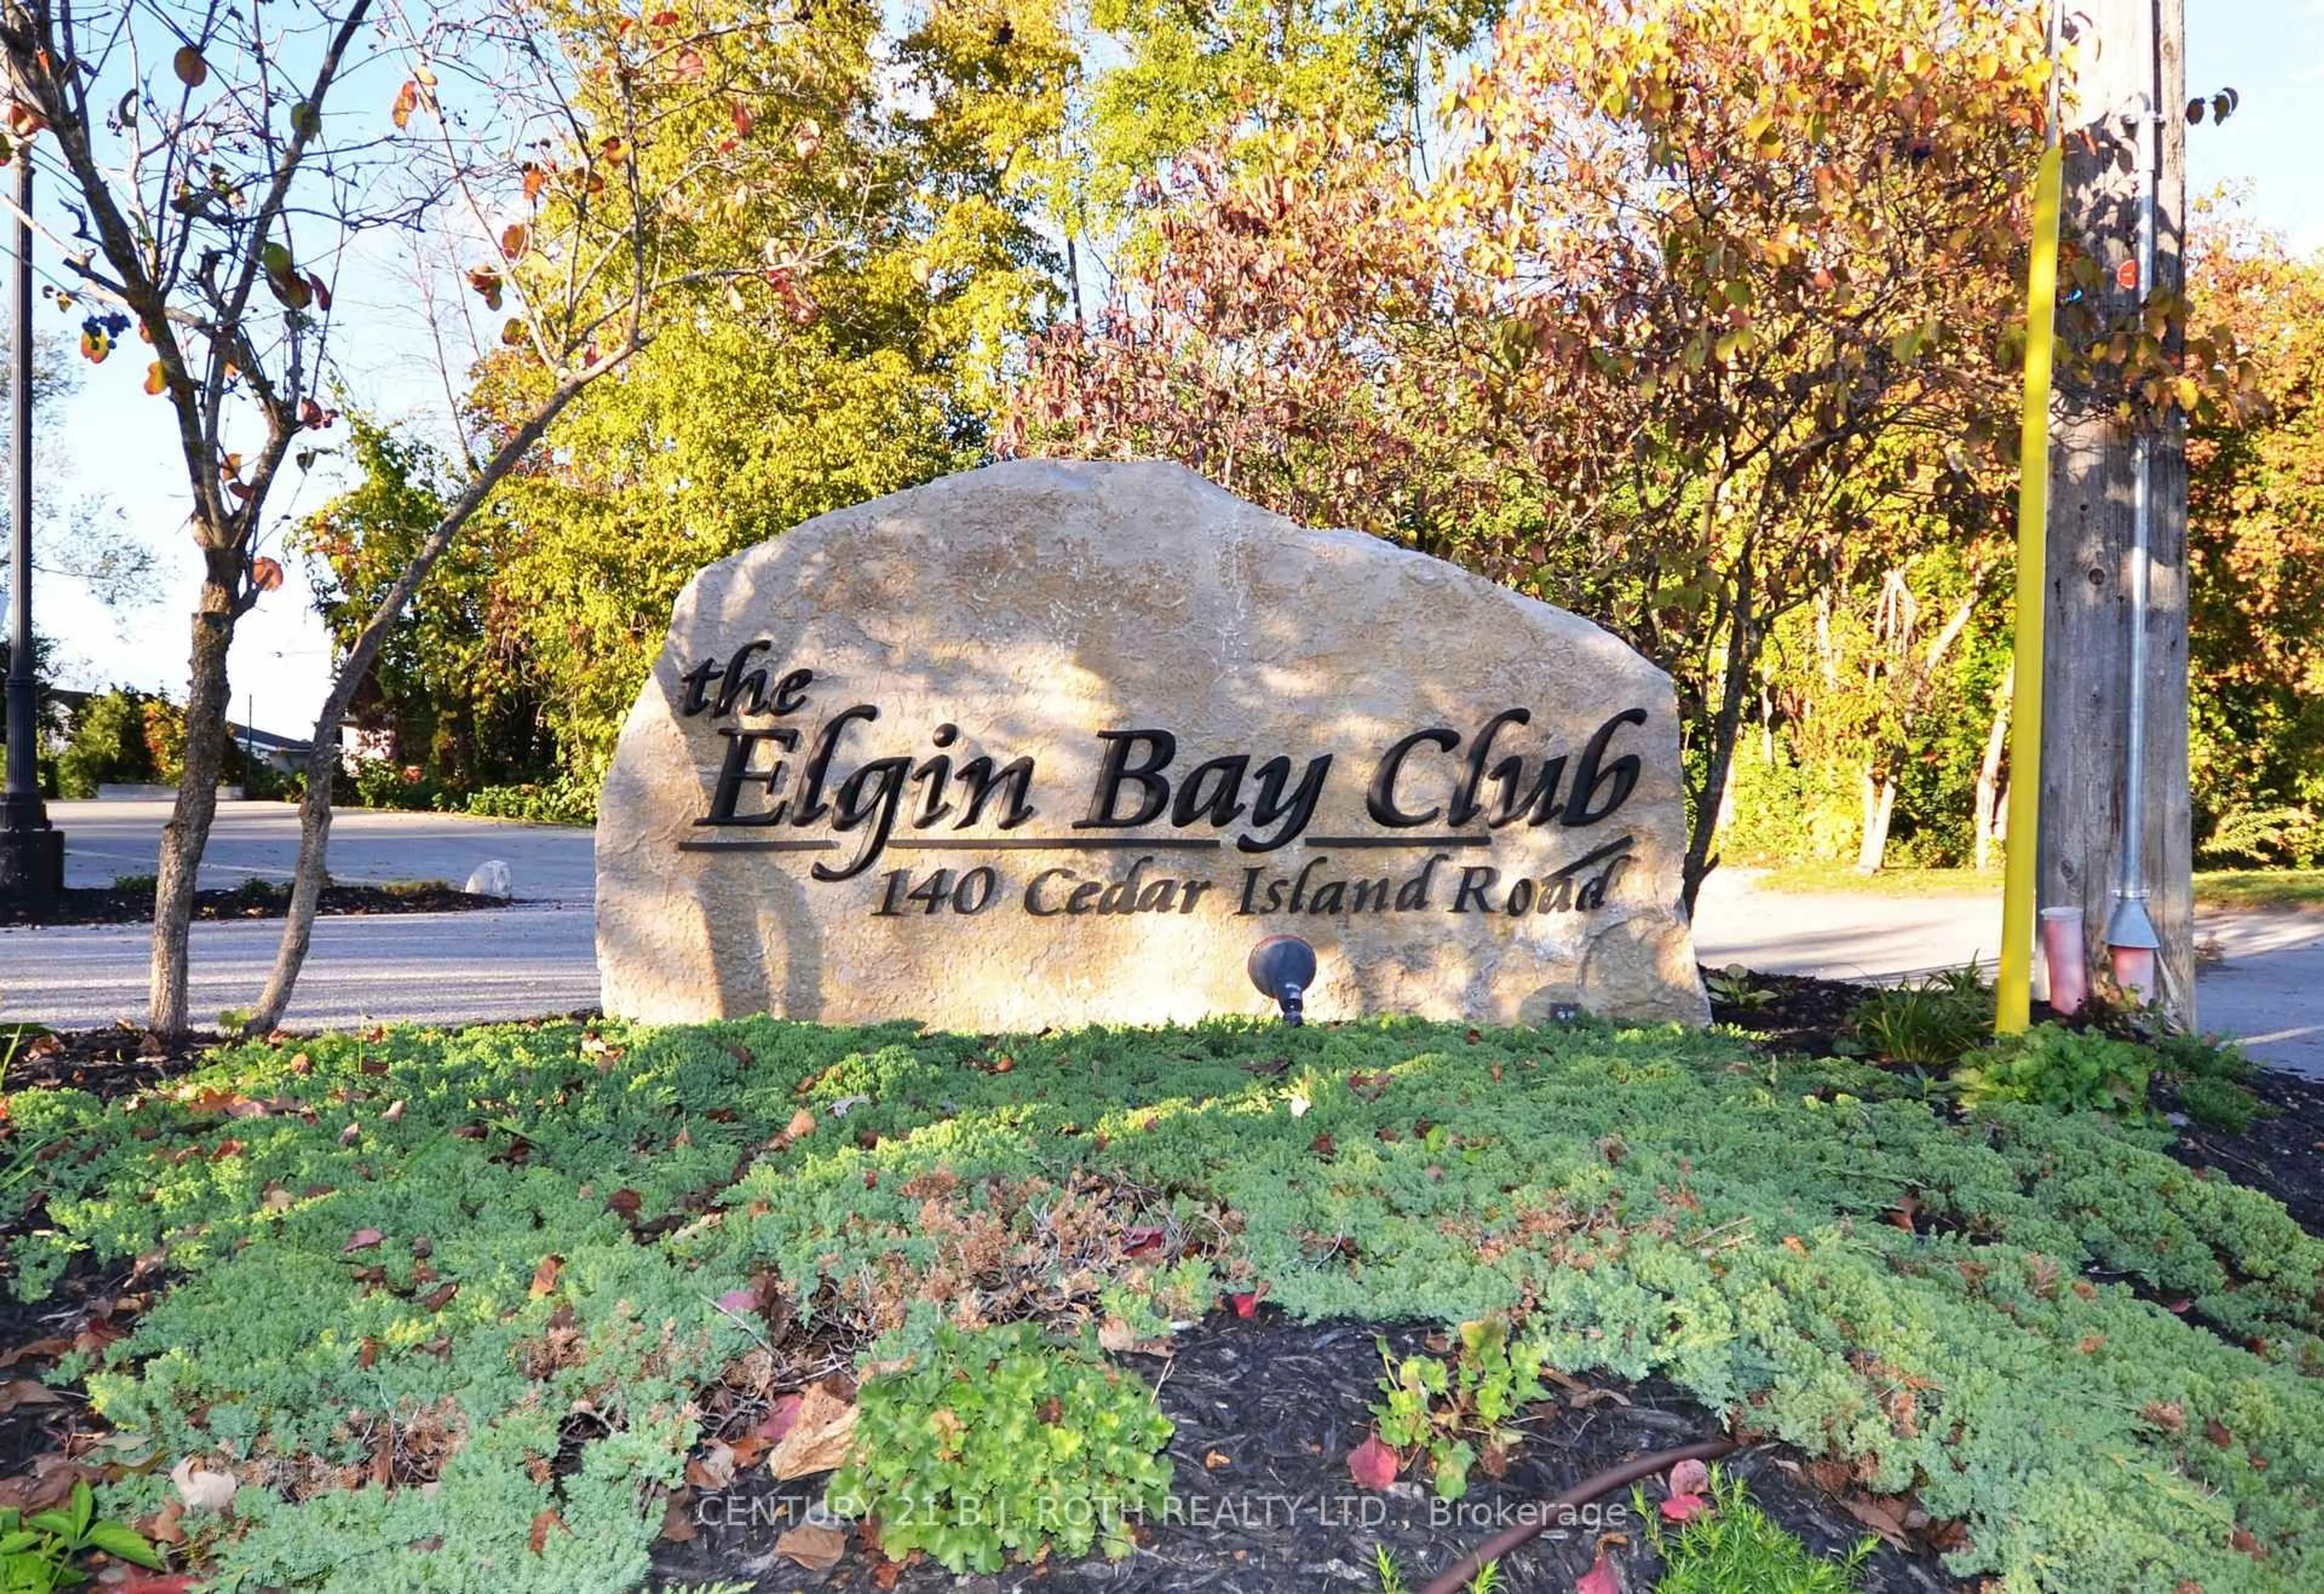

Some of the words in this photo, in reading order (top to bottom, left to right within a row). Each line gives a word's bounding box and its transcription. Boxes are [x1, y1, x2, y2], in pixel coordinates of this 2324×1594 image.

[682, 640, 813, 718] the
[694, 704, 1034, 882] Elgin
[1072, 729, 1333, 853] Bay
[1366, 707, 1649, 829] Club
[871, 866, 995, 917] 140
[1023, 855, 1211, 917] Cedar
[1234, 855, 1449, 917] Island
[1446, 854, 1638, 918] Road
